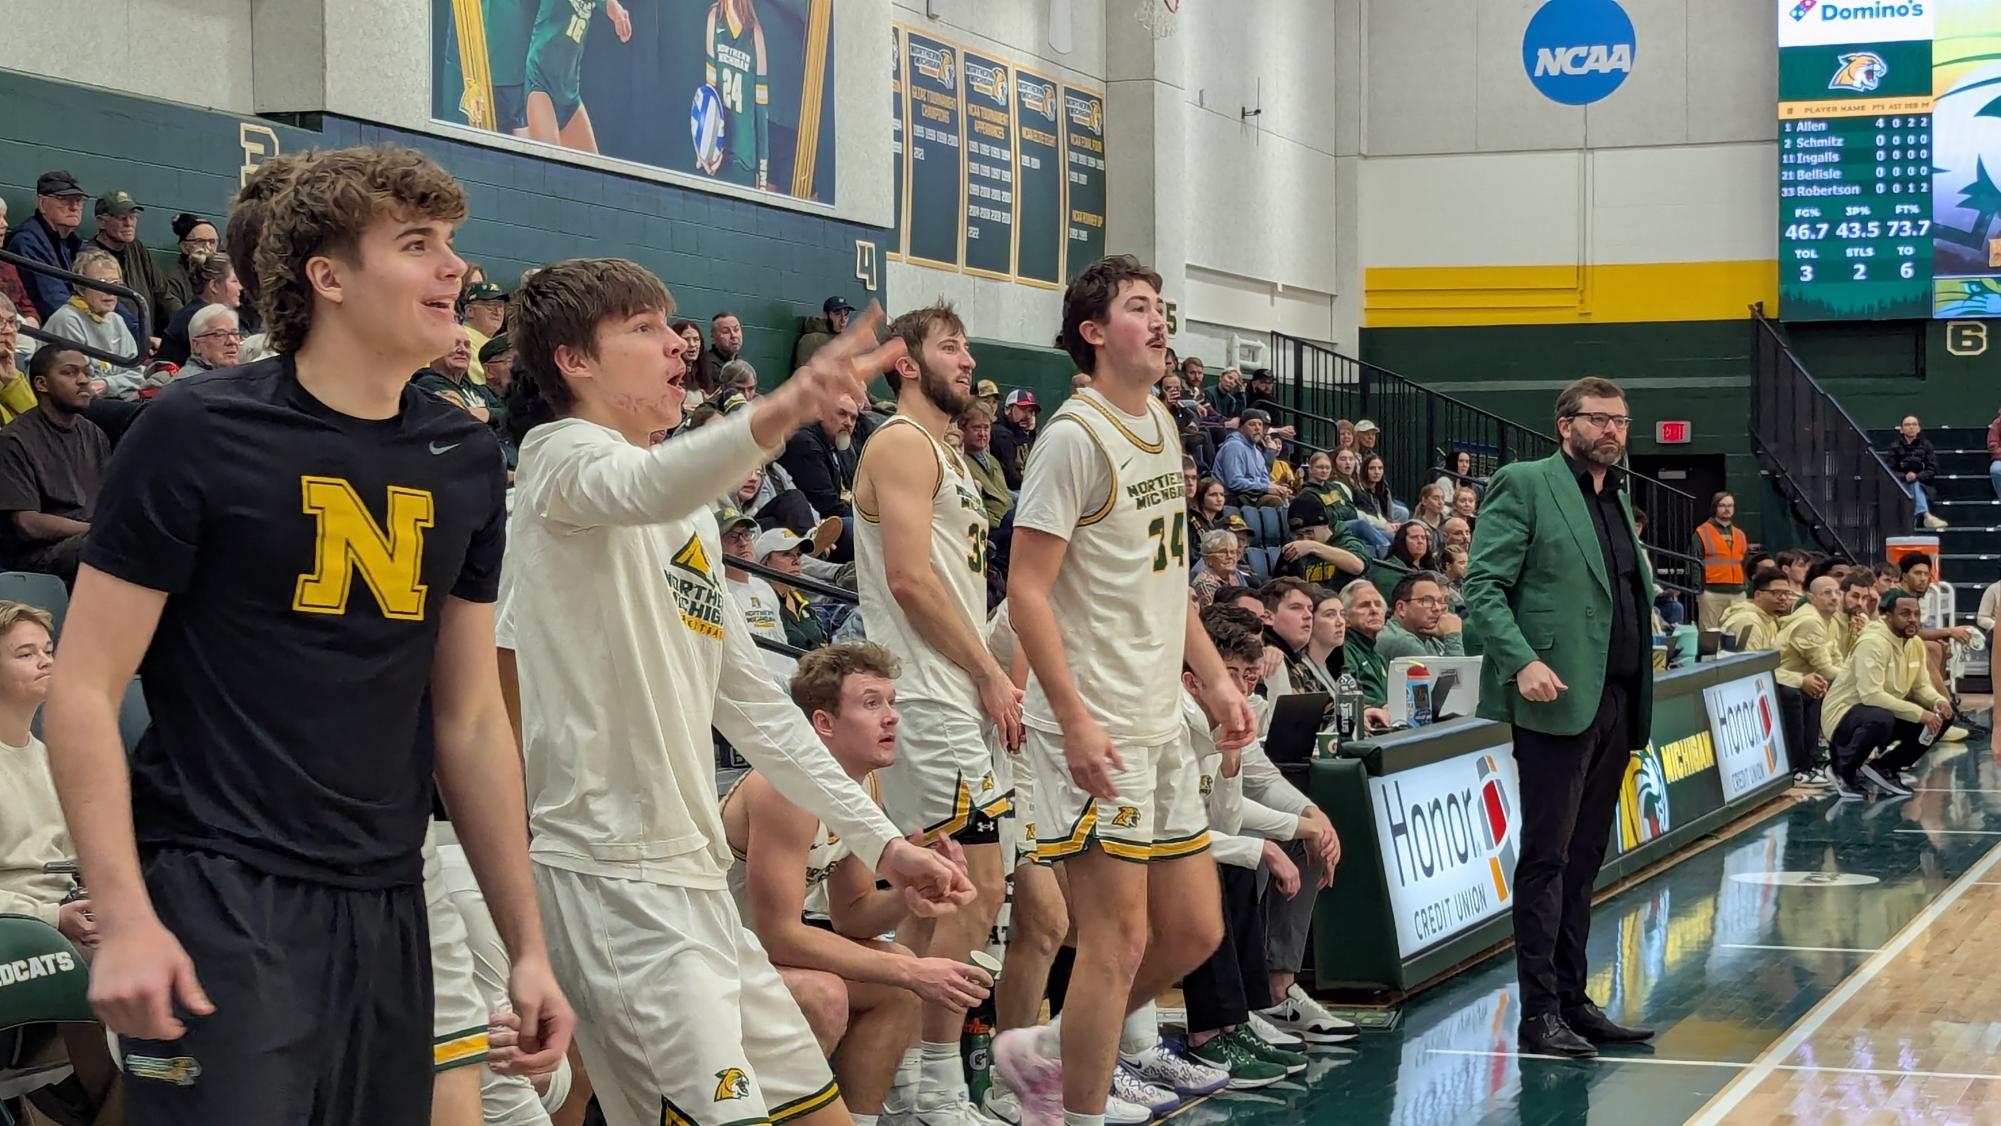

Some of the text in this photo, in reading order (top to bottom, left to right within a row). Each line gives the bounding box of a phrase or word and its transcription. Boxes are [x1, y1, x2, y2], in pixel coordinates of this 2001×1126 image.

[1821, 0, 1924, 21] Domino's
[565, 14, 587, 44] 16
[1534, 44, 1631, 77] NCAA
[722, 68, 743, 113] 24
[1804, 106, 1837, 114] PLAYER
[1840, 104, 1866, 112] NAME
[1784, 117, 1928, 132] 1 Allen 4 0 2 2
[1784, 134, 1928, 149] 2 Schmitz 0 0 0 0
[1782, 149, 1928, 165] 11 Ingalls 0 0 0 0
[1781, 165, 1928, 180] 21 Bellisle 0 0 0 0
[1781, 182, 1928, 197] 33 Robertson 0 0 1 2
[1795, 204, 1920, 218] FG% 3P% FT%
[1785, 219, 1931, 240] 46.7 43.5 73.7
[855, 239, 877, 291] 4
[1795, 246, 1916, 259] TOL STLS TO
[1799, 261, 1915, 282] 3 2 6
[1163, 299, 1178, 337] 5
[1946, 320, 1988, 356] 6
[292, 475, 435, 621] N
[1714, 689, 1757, 758] Honor
[1660, 730, 1715, 784] MICHIGAN
[1382, 780, 1472, 887] Honor
[1414, 882, 1488, 940] CREDIT UNION
[0, 951, 75, 987] DCATS
